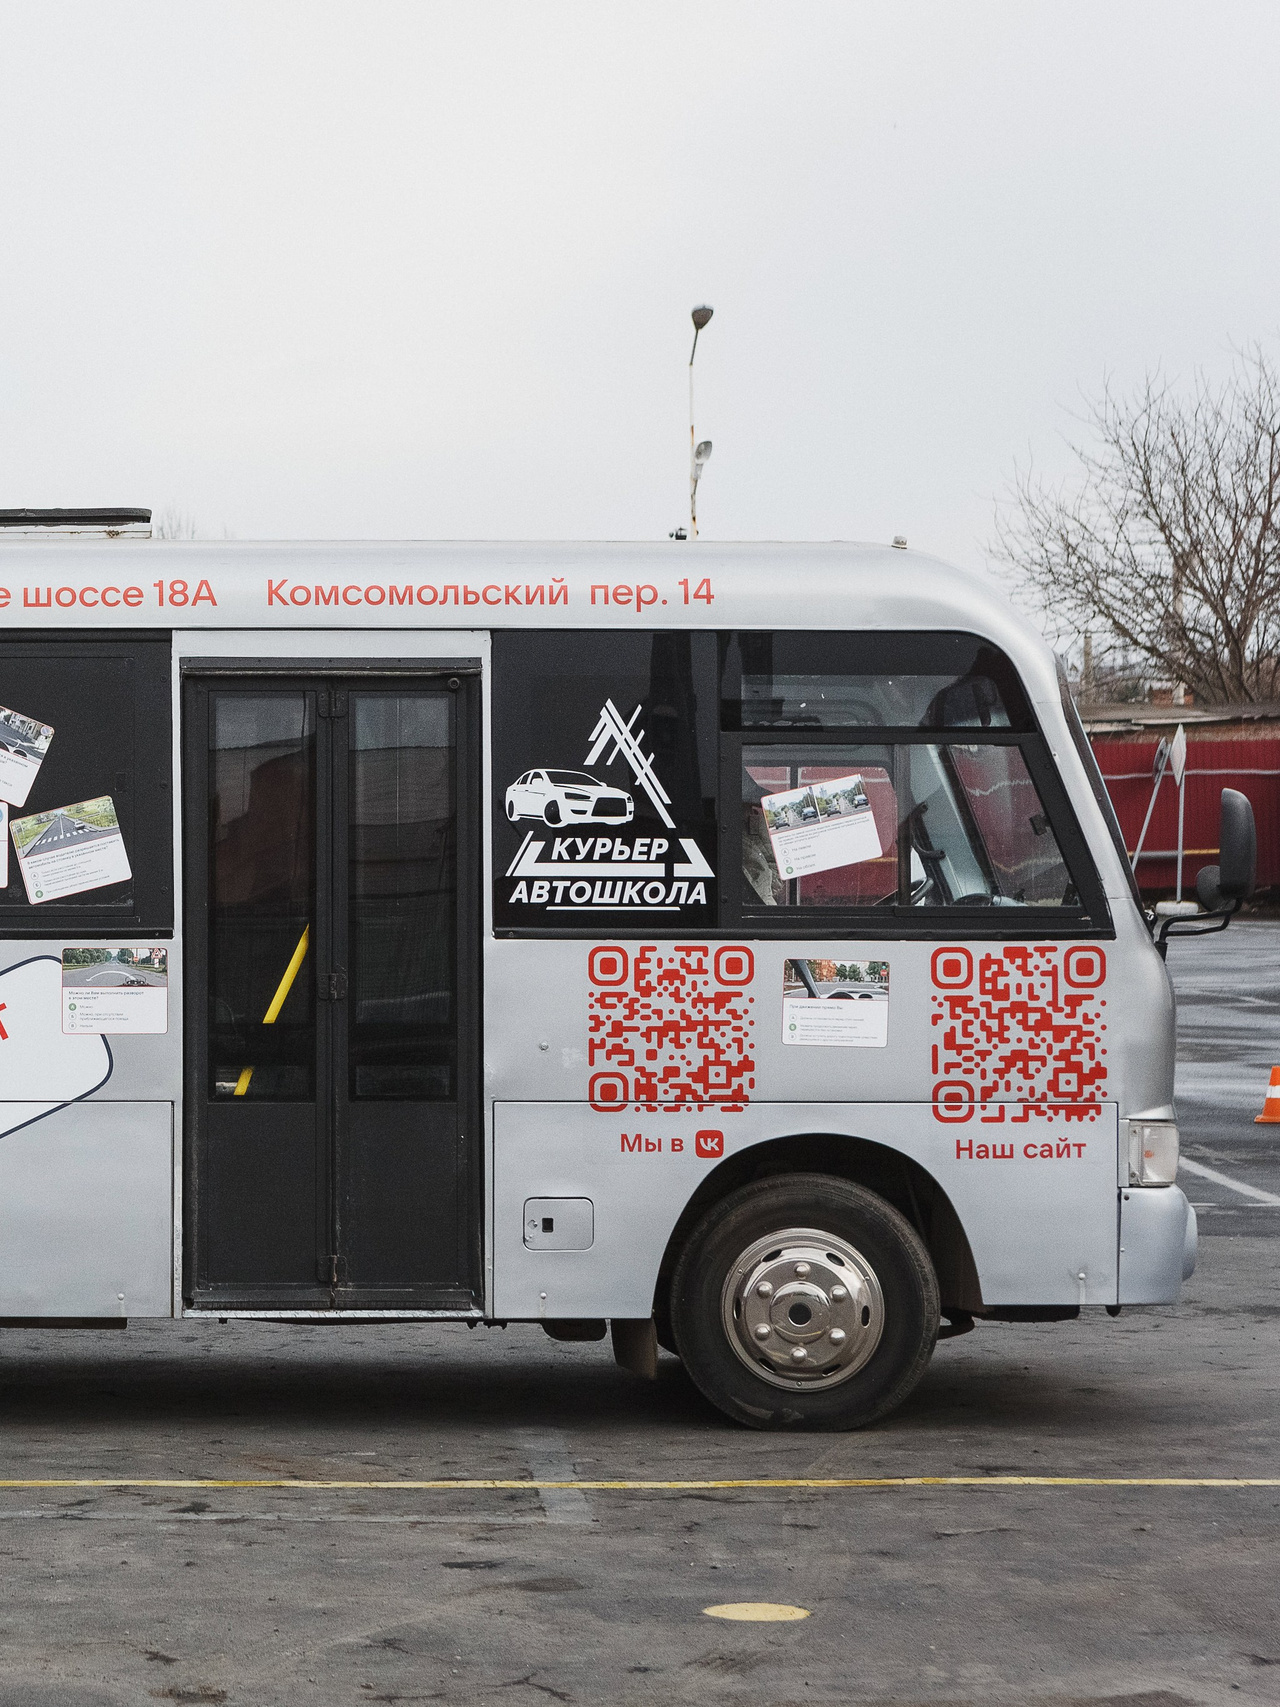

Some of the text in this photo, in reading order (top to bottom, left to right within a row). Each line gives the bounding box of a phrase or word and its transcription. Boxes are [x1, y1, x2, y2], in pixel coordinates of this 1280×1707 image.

[22, 586, 145, 608] шоссе
[152, 579, 218, 608] 18А
[267, 577, 716, 613] Комсомольский пер. 14
[550, 837, 670, 861] КУРЬЕР
[508, 880, 708, 905] АВТОШКОЛА
[620, 1133, 662, 1153] Мы
[670, 1137, 684, 1153] в
[954, 1135, 1088, 1161] Наш сайт
